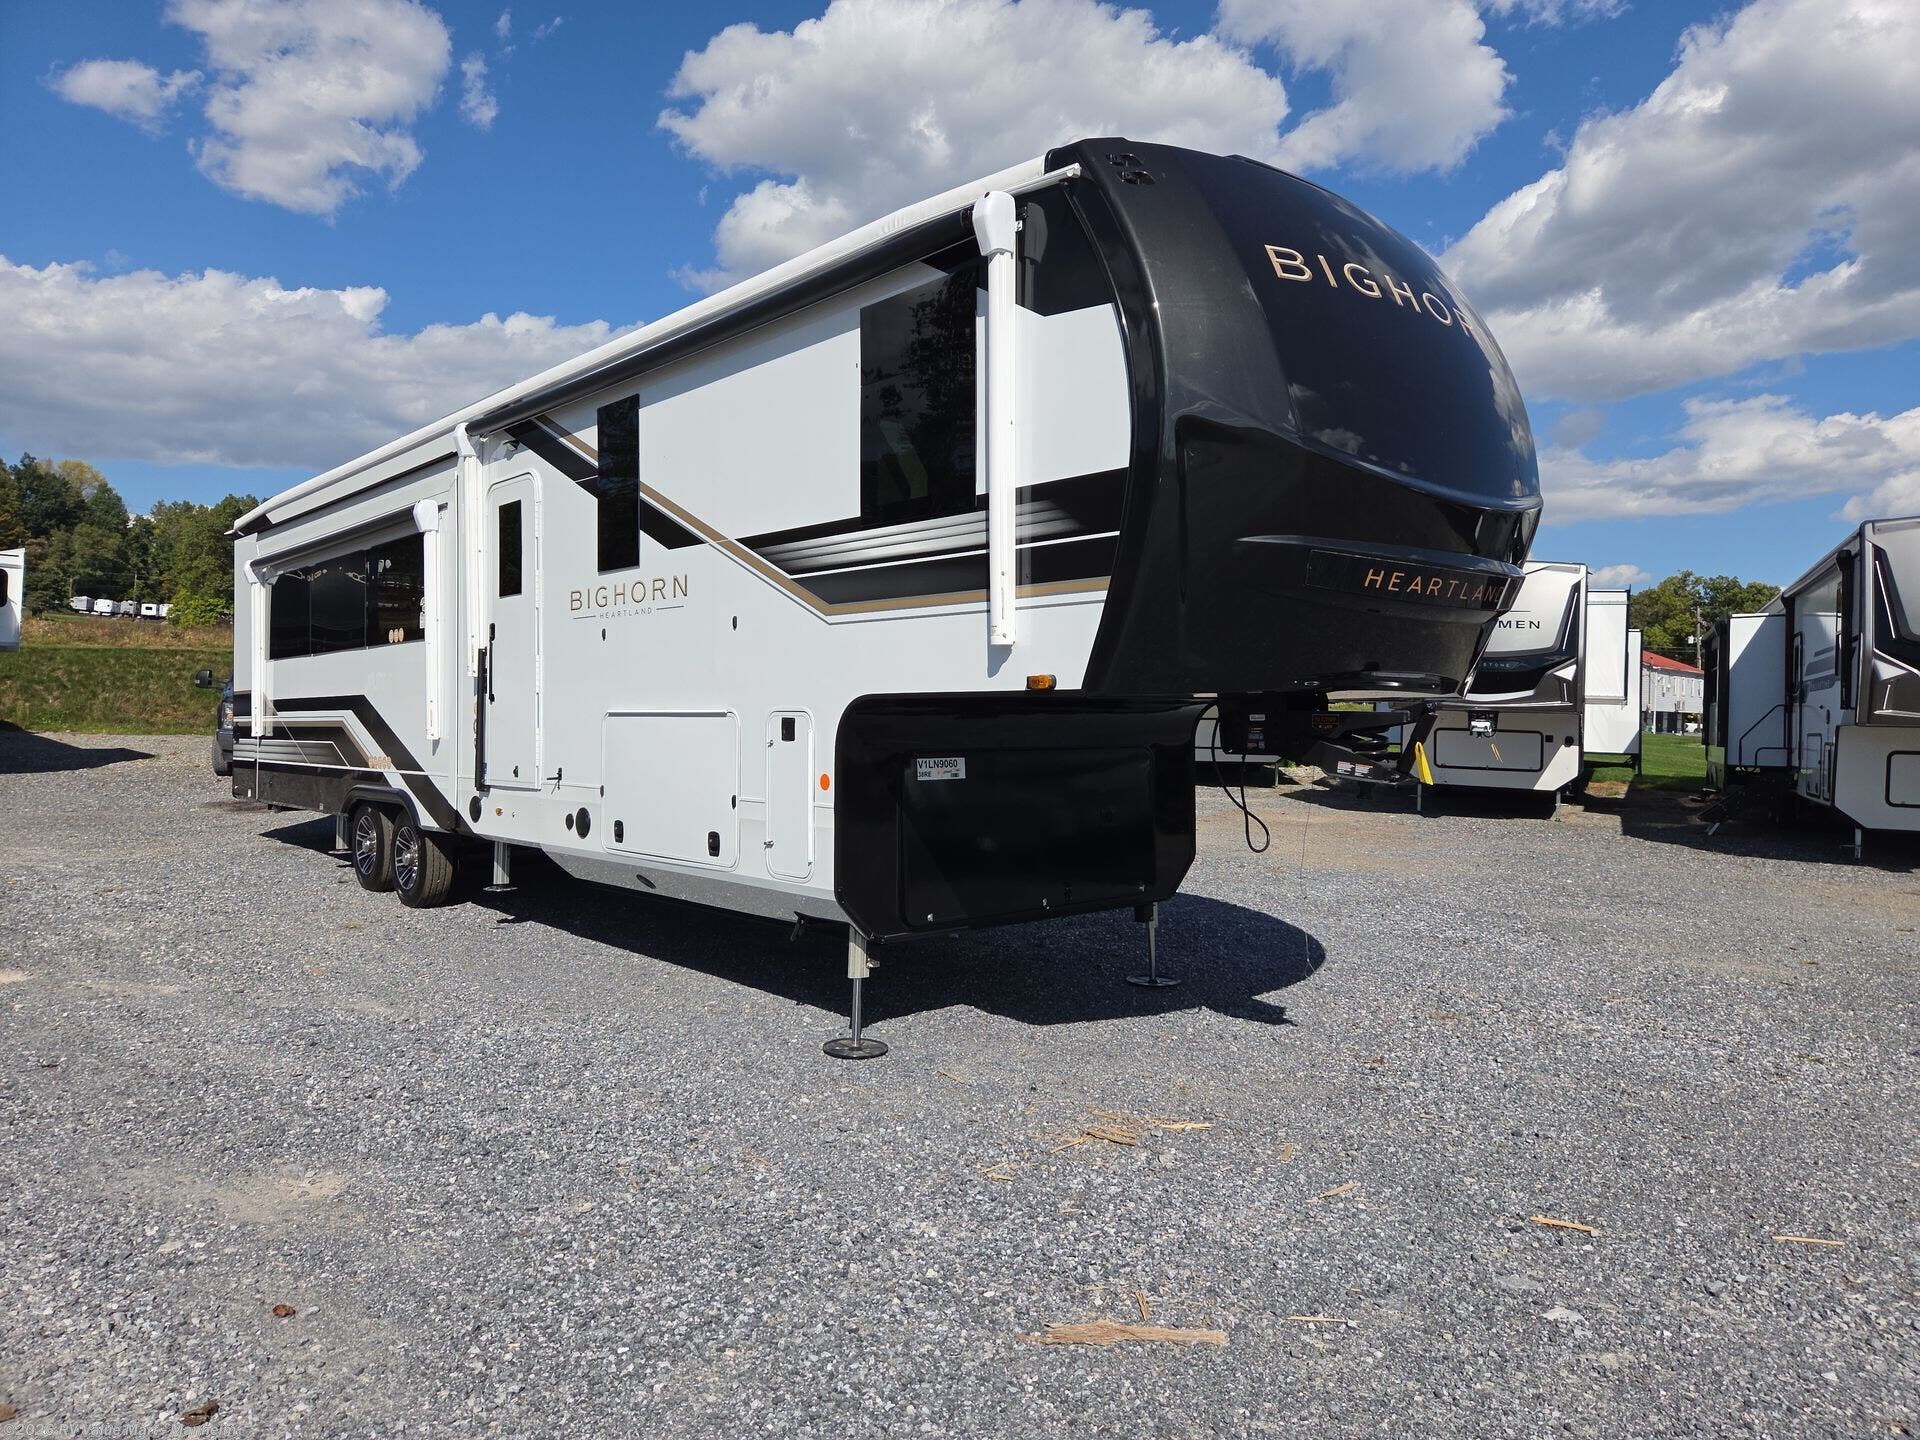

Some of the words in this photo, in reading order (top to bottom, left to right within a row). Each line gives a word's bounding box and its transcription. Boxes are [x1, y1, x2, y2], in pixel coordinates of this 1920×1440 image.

[1364, 568, 1505, 603] HEARTLAND
[570, 573, 689, 612] BIGHORN
[599, 607, 653, 619] HEARTLAND
[1498, 620, 1540, 629] MEN
[917, 758, 958, 769] V1LN9060
